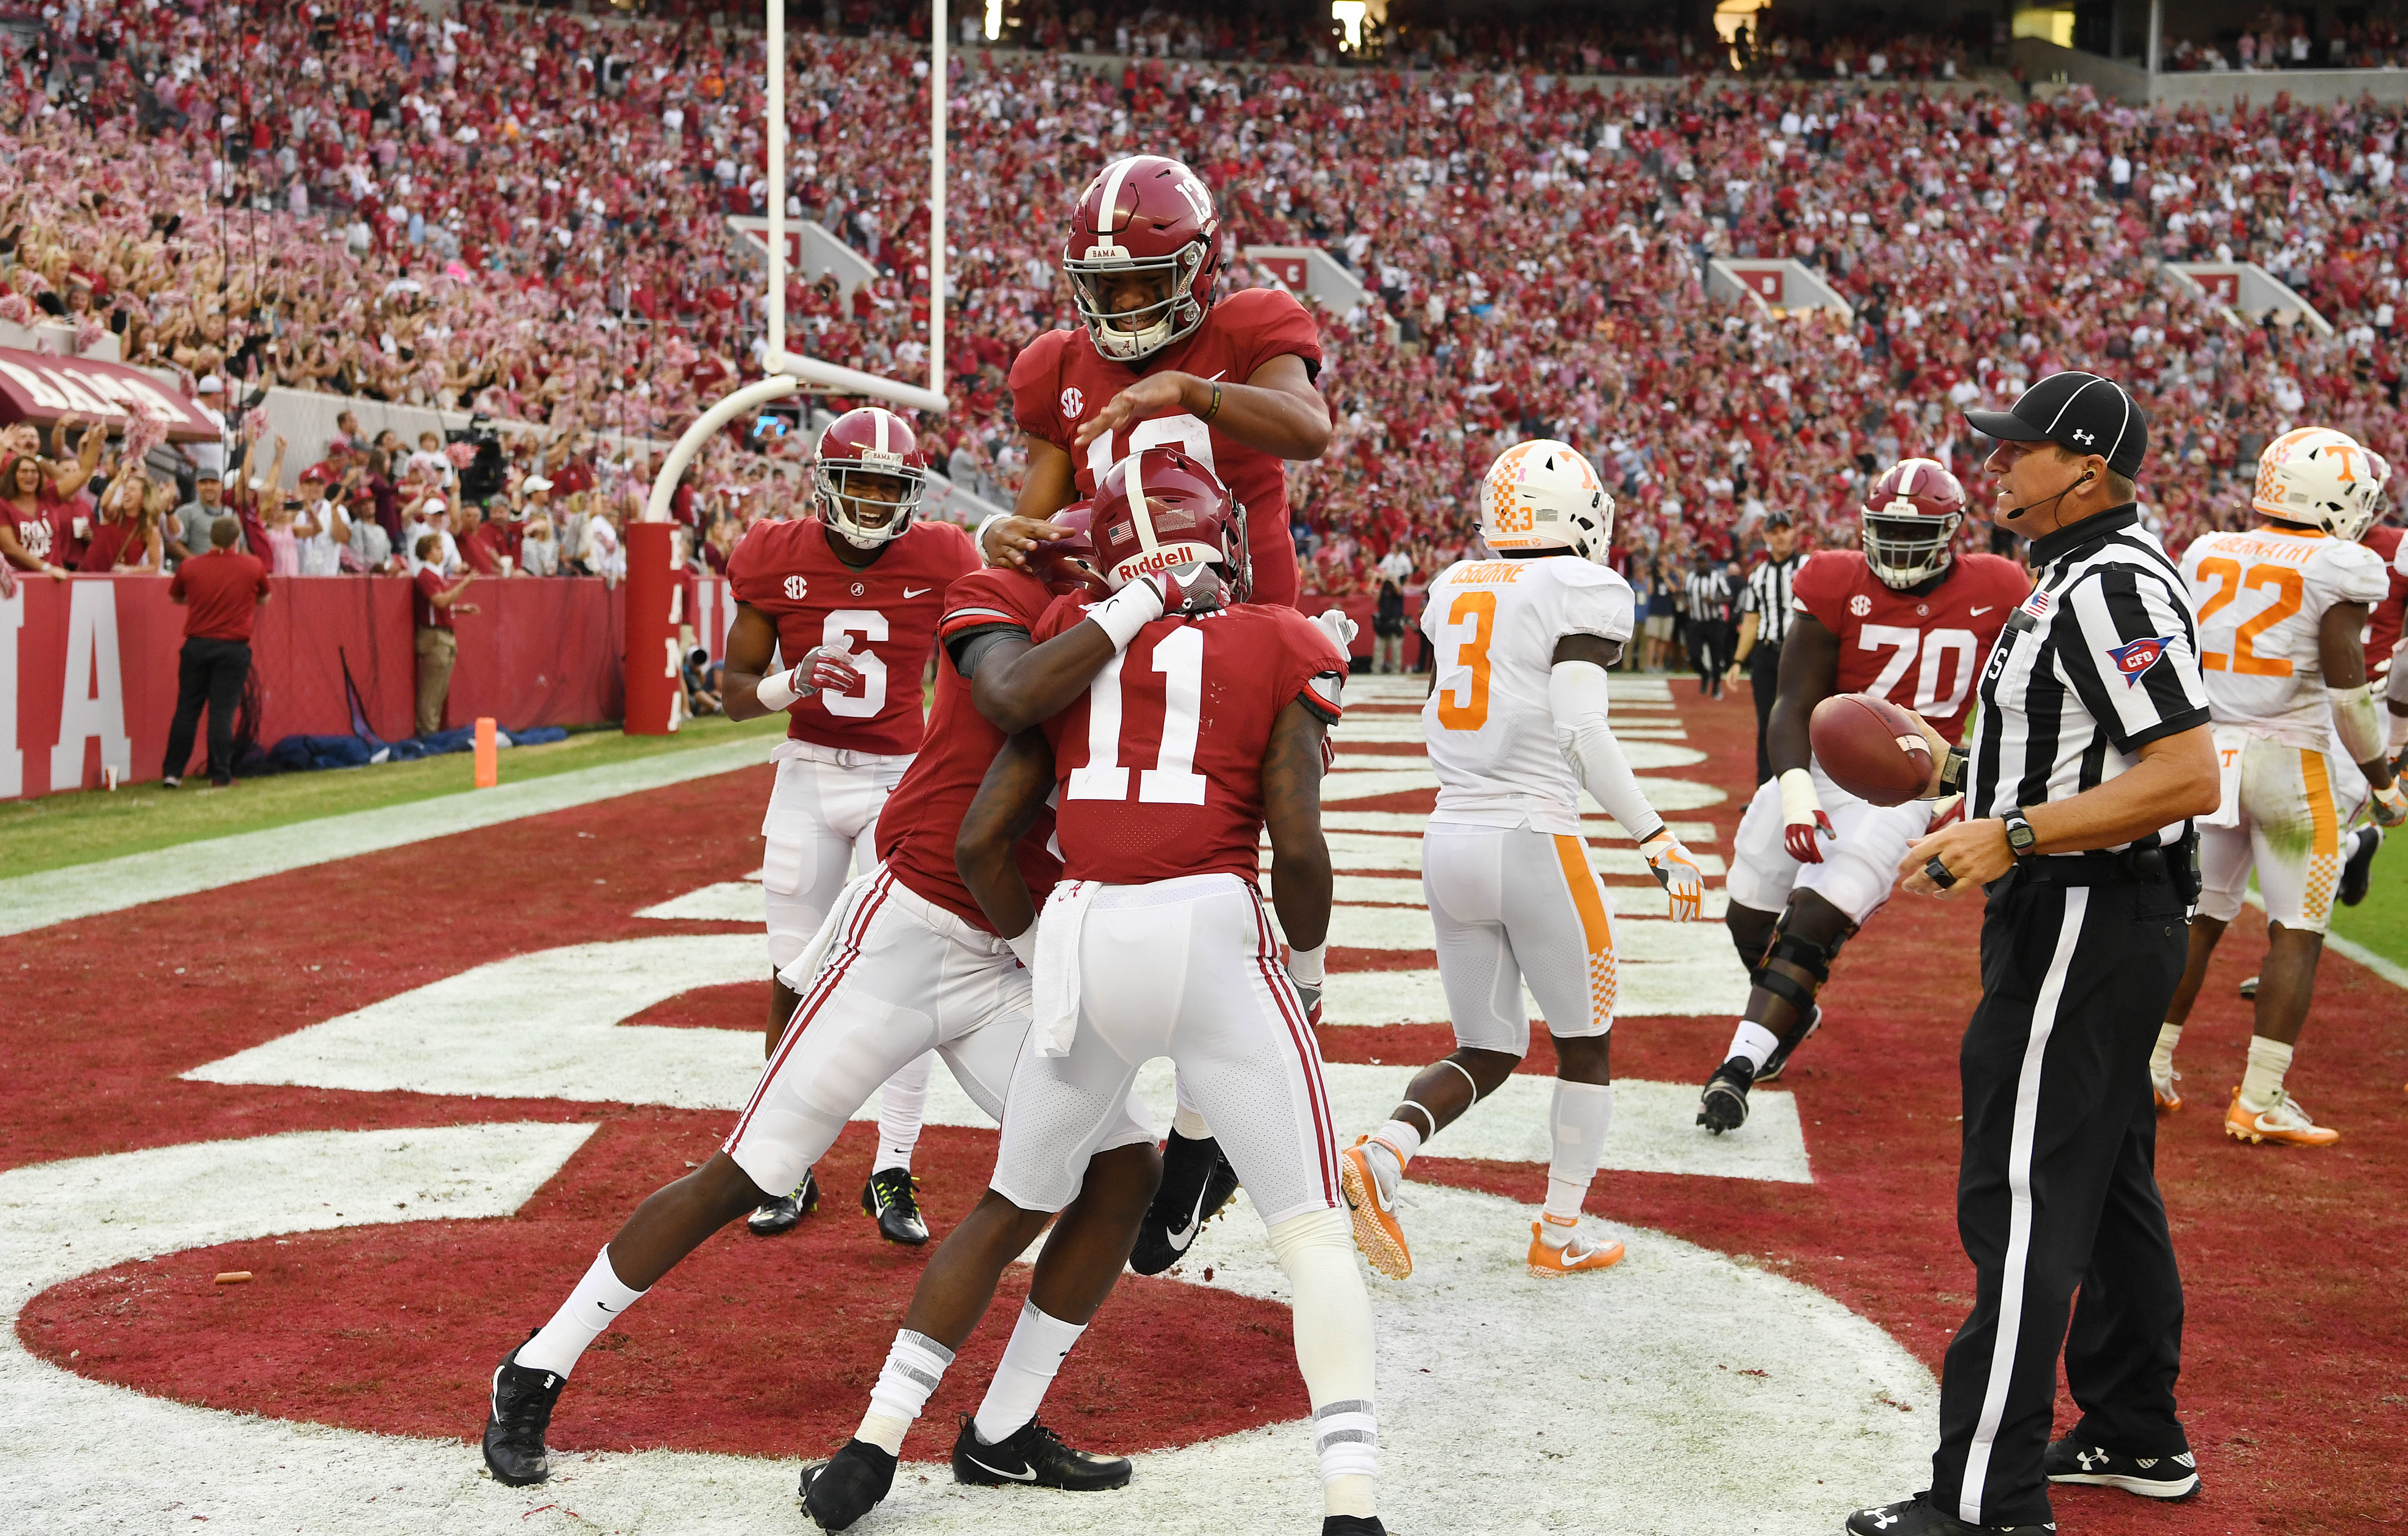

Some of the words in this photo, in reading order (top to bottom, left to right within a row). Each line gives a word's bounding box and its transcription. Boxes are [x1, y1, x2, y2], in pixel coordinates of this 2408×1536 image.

[1174, 178, 1212, 225] 13
[1061, 387, 1083, 419] SEC
[2274, 485, 2286, 503] 2
[1519, 507, 1533, 531] 3
[1118, 546, 1193, 582] Riddell
[2207, 537, 2322, 563] ABERNATHY
[784, 575, 807, 600] SEC
[1450, 562, 1535, 584] OSBORNE
[1850, 594, 1872, 617] SEC
[2196, 556, 2304, 677] 22
[822, 609, 889, 718] 6
[1438, 591, 1497, 731] 3
[1858, 623, 1979, 718] 70
[1989, 647, 2008, 680] S
[2126, 650, 2154, 668] CFO
[1067, 625, 1207, 806] 11
[2221, 749, 2238, 768] T
